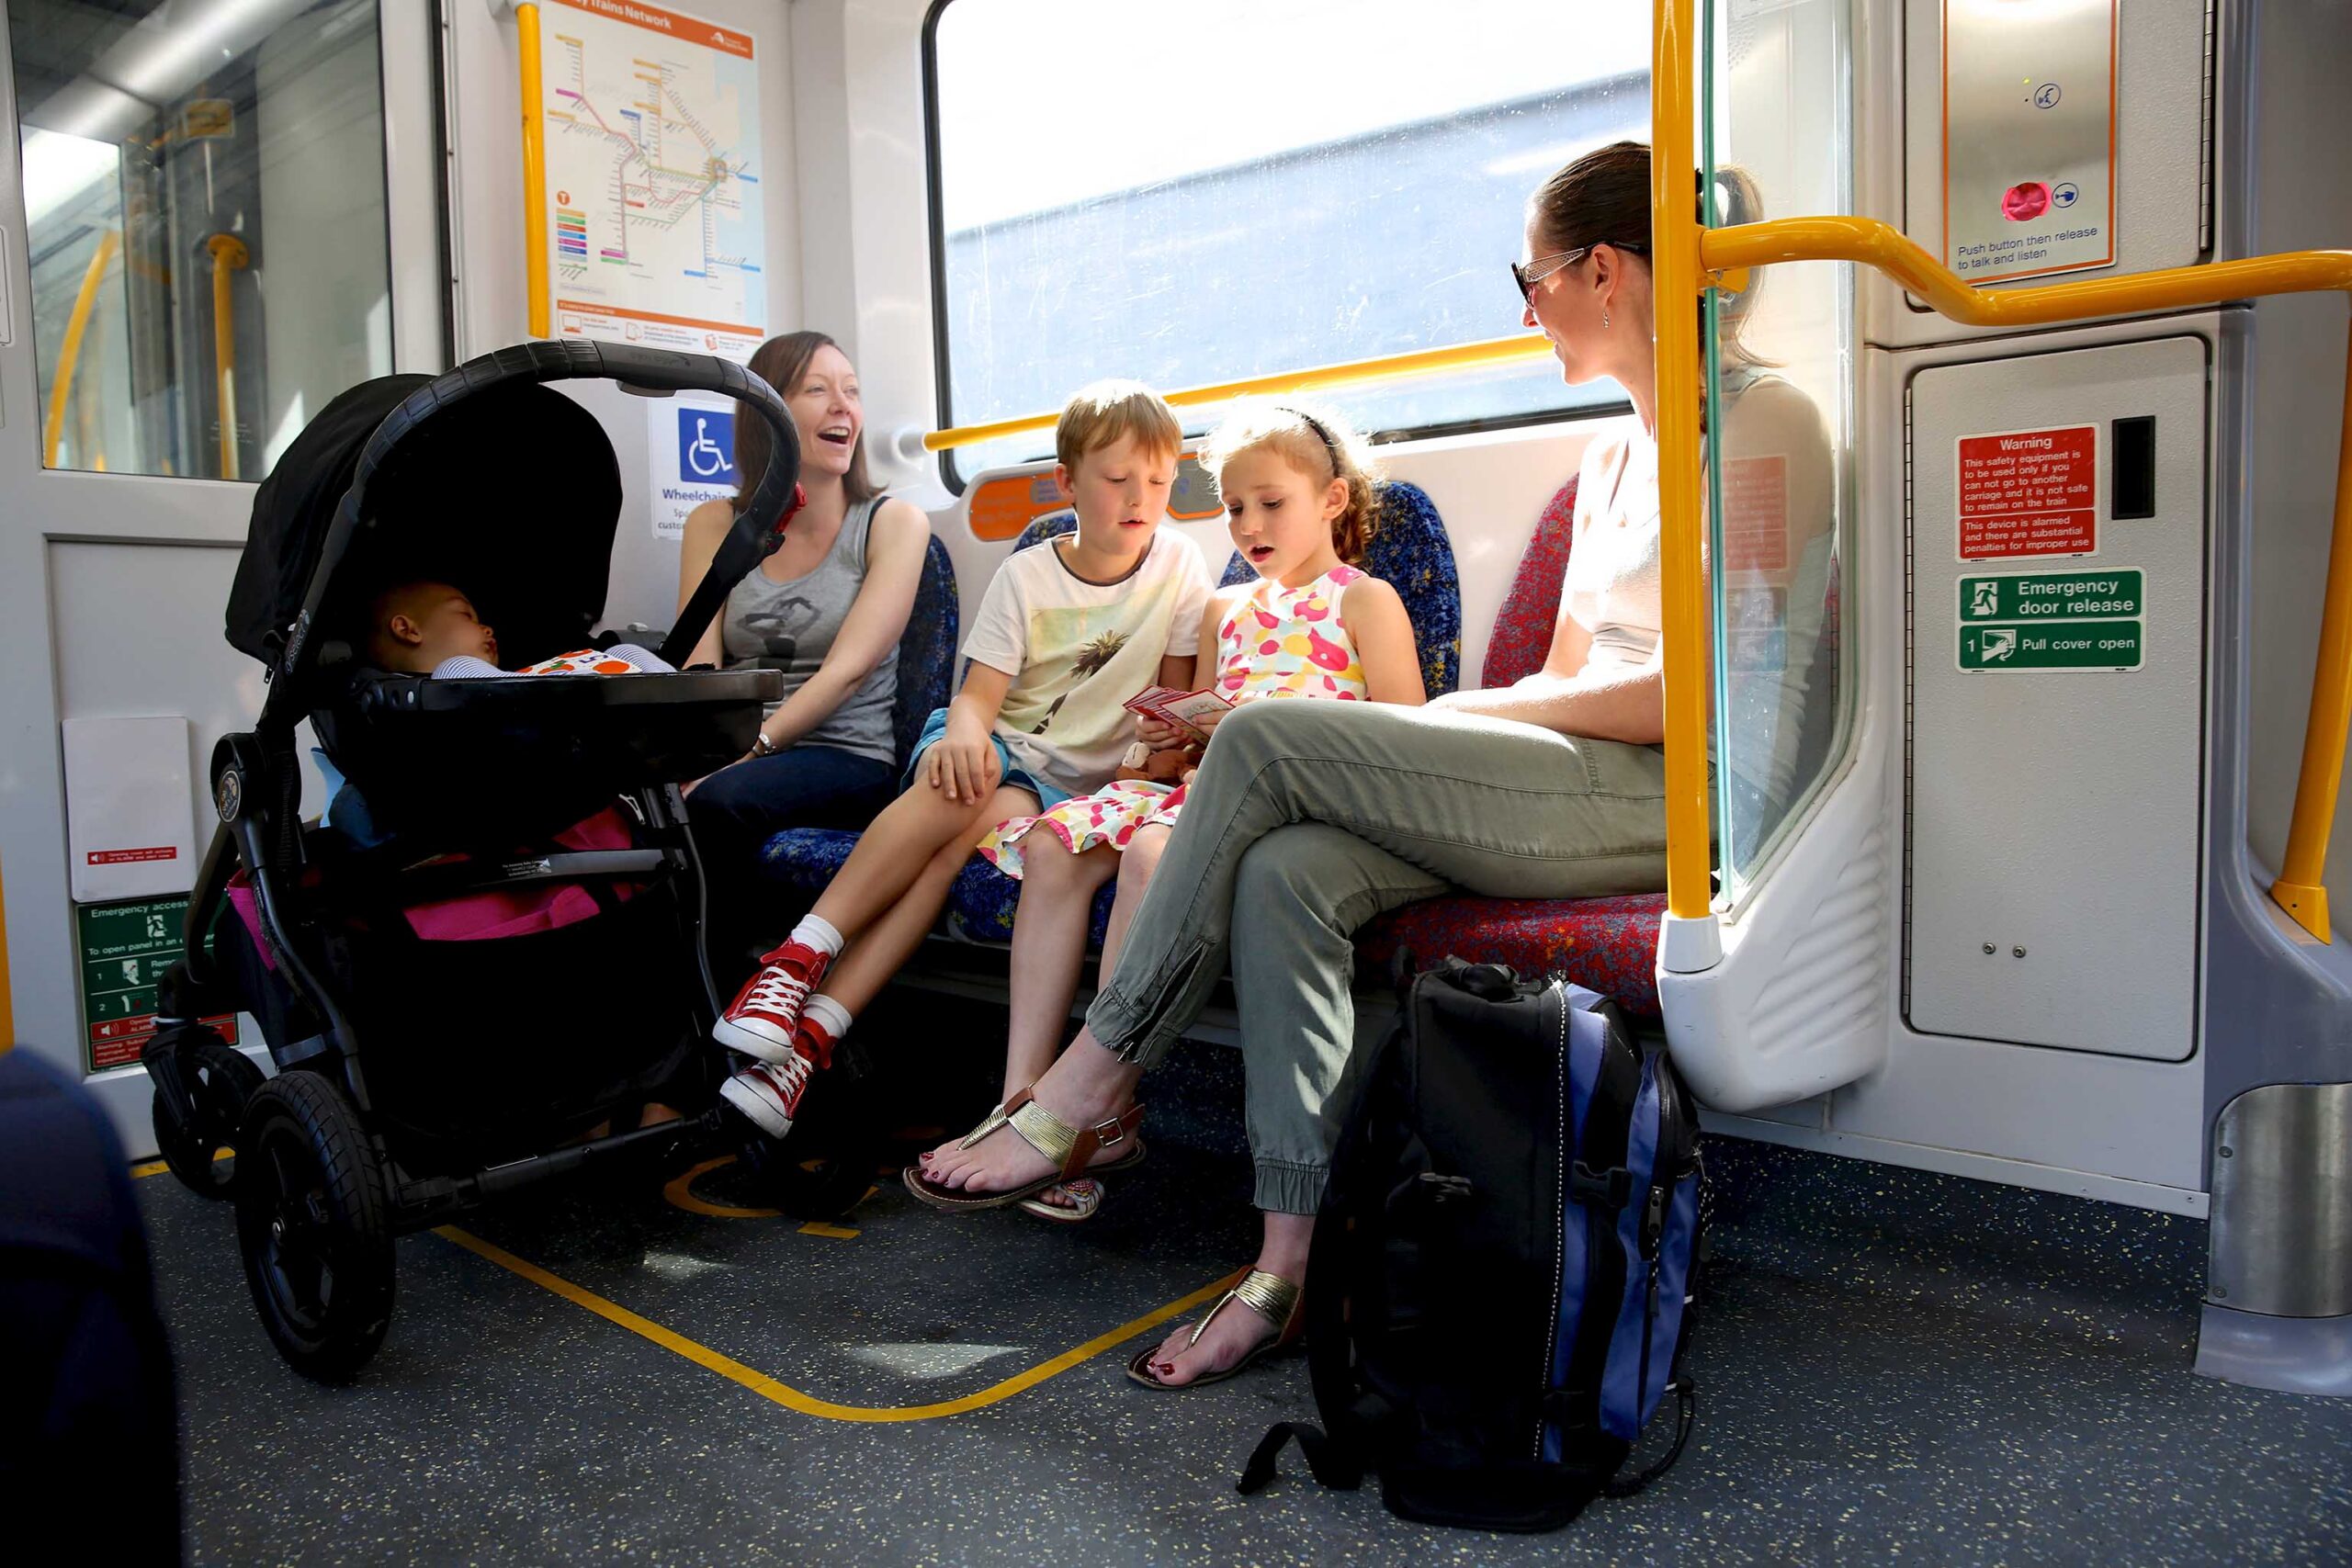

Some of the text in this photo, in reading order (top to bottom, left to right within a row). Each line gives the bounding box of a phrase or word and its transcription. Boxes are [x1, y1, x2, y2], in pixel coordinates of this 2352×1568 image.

[625, 5, 673, 29] Network
[1958, 227, 2098, 256] Push button then release
[1958, 248, 2048, 270] to talk and listen
[1999, 436, 2052, 451] Warning
[1964, 450, 2081, 468] This safety equipment is
[1964, 463, 2070, 479] to be used only if you
[1964, 474, 2068, 491] can not go to another
[1964, 483, 2088, 502] carriage and it is not safe
[1964, 496, 2067, 512] to remain on the train
[1964, 515, 2070, 532] This device is alarmed
[1964, 526, 2083, 542] and there are substantial
[1964, 537, 2089, 554] penalties for improper use
[2018, 581, 2120, 597] Emergency
[2018, 598, 2135, 615] door release
[1967, 639, 1975, 652] 1
[2022, 638, 2135, 650] Pull cover open
[91, 901, 188, 918] Emergency access
[88, 947, 99, 955] To
[102, 946, 126, 954] open
[129, 941, 153, 952] panel
[98, 1003, 106, 1011] 2
